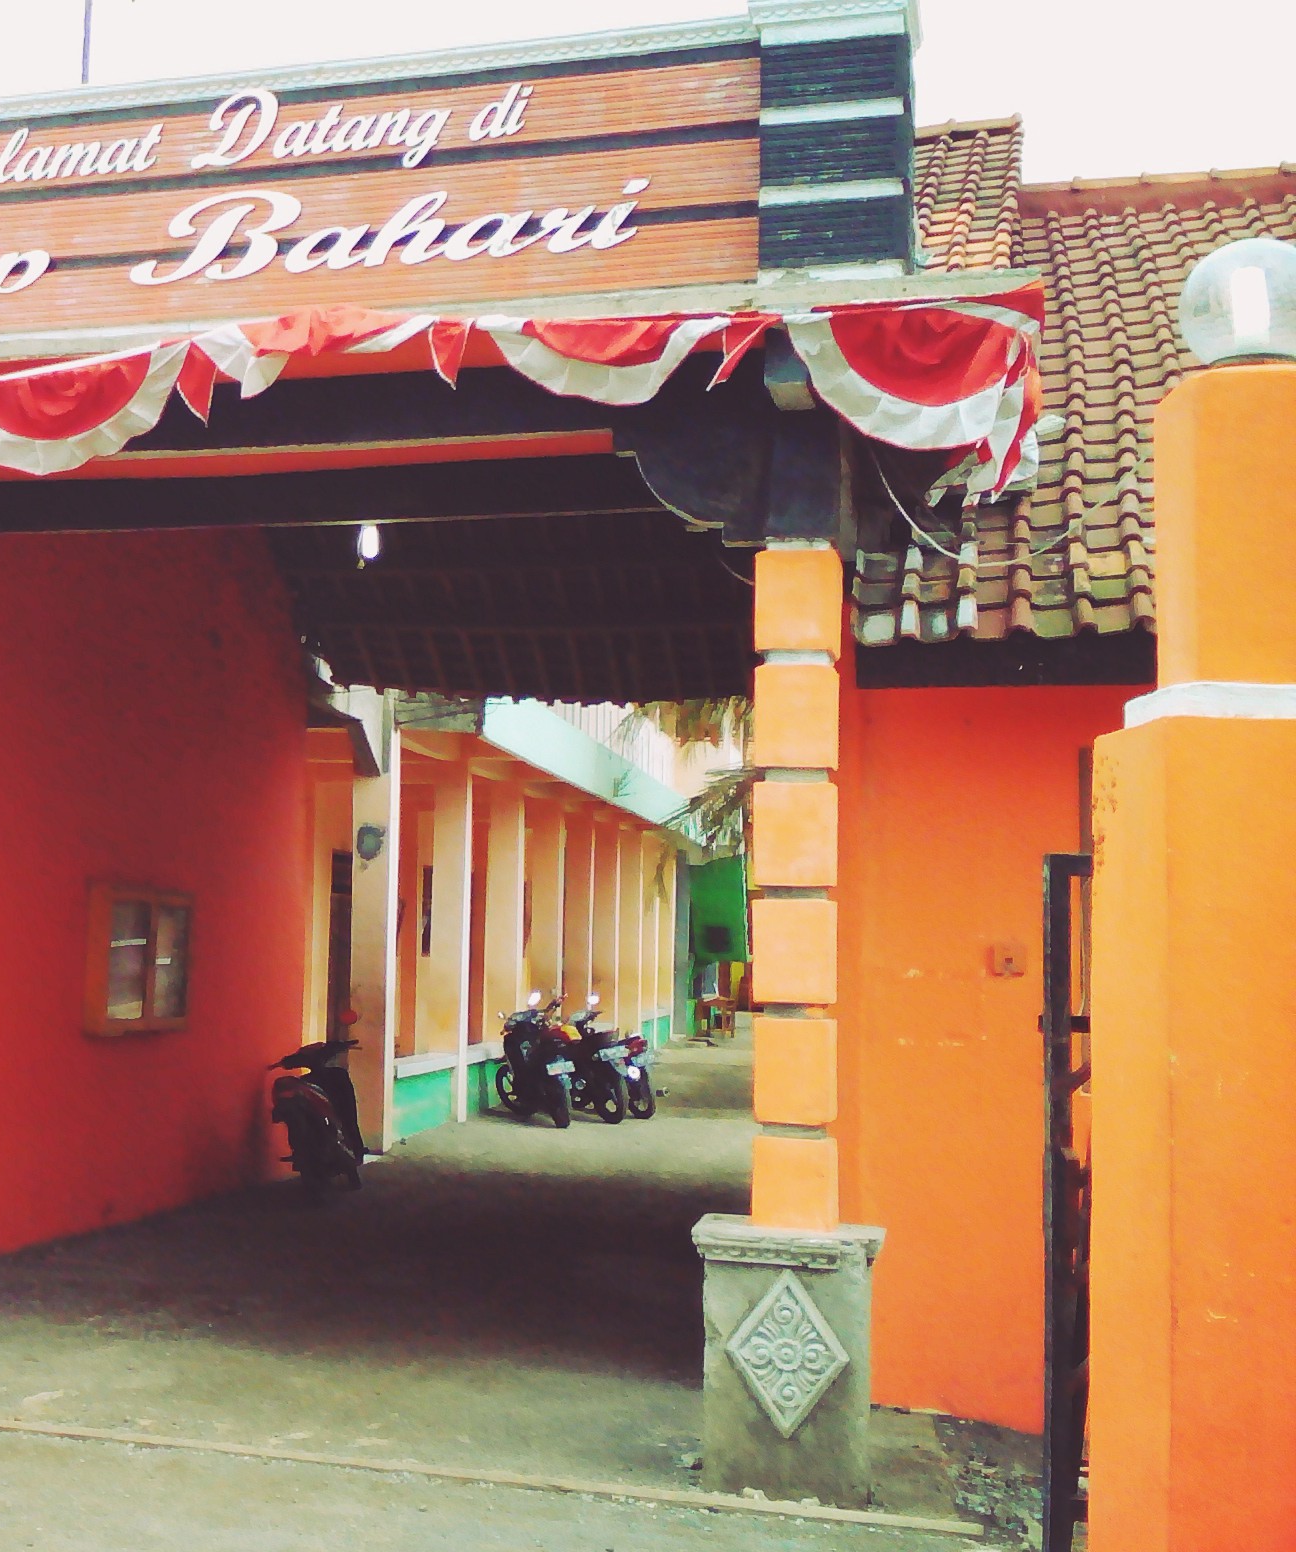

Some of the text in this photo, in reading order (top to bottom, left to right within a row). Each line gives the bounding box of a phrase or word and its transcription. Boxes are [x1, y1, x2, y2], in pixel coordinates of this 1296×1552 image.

[190, 89, 452, 169] Datang
[468, 82, 532, 142] di
[129, 176, 650, 285] Bahari
